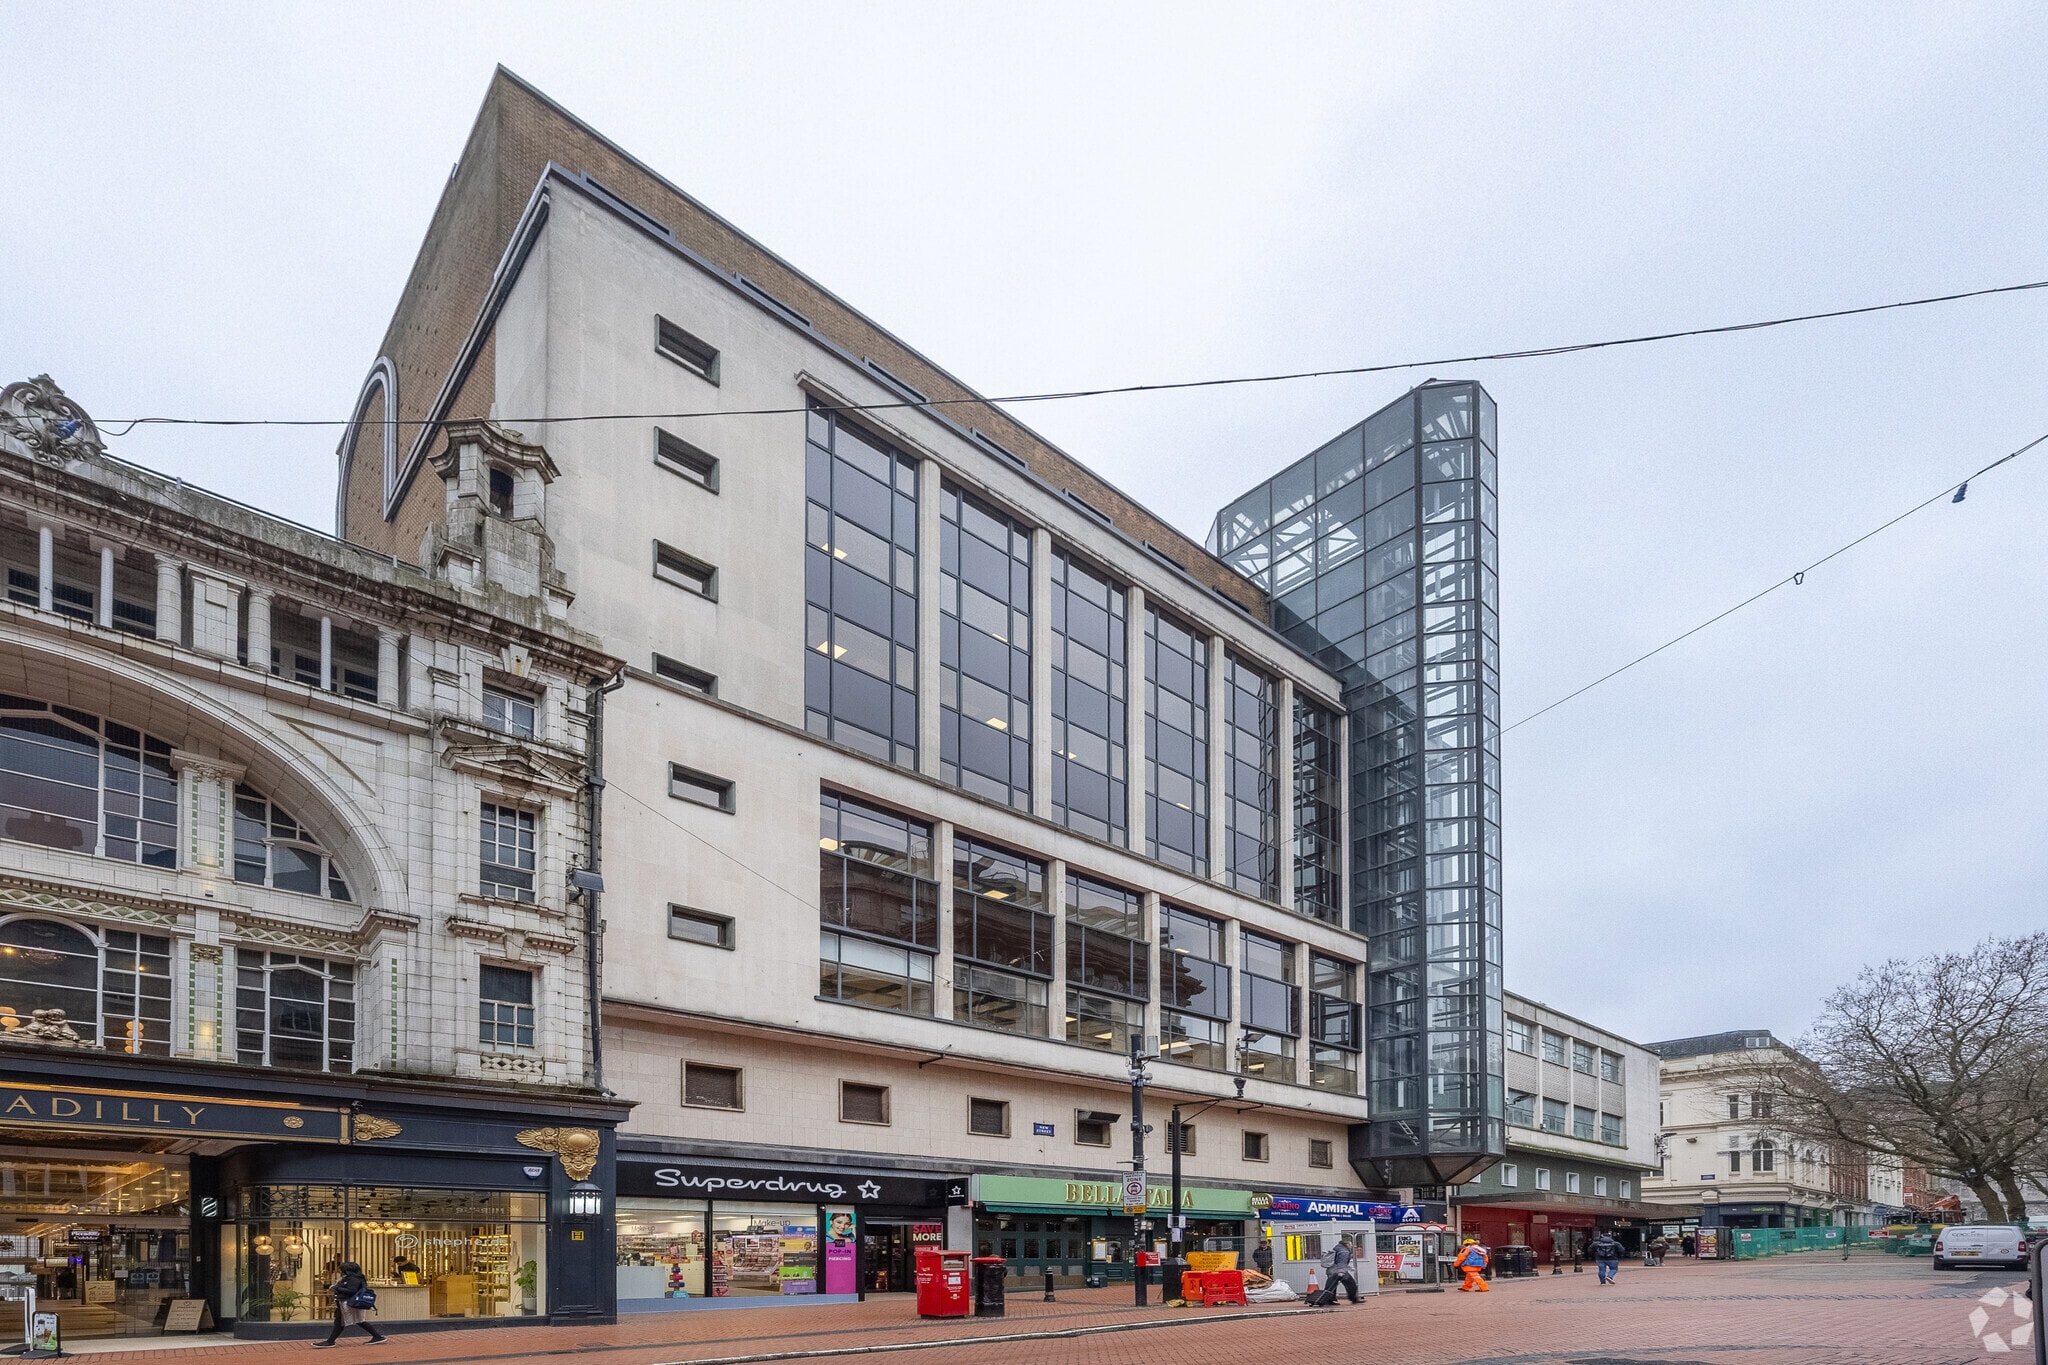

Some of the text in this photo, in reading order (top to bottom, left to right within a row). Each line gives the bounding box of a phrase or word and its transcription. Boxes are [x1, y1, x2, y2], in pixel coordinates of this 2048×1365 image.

[5, 1094, 206, 1125] ADILLY
[654, 1168, 847, 1199] Superdrug
[1146, 1188, 1194, 1208] TALA
[1307, 1202, 1363, 1216] ADMIRAL
[754, 1219, 791, 1228] Make-up
[912, 1224, 940, 1234] SAVE
[424, 1237, 508, 1246] shepherds
[912, 1233, 942, 1241] MORE
